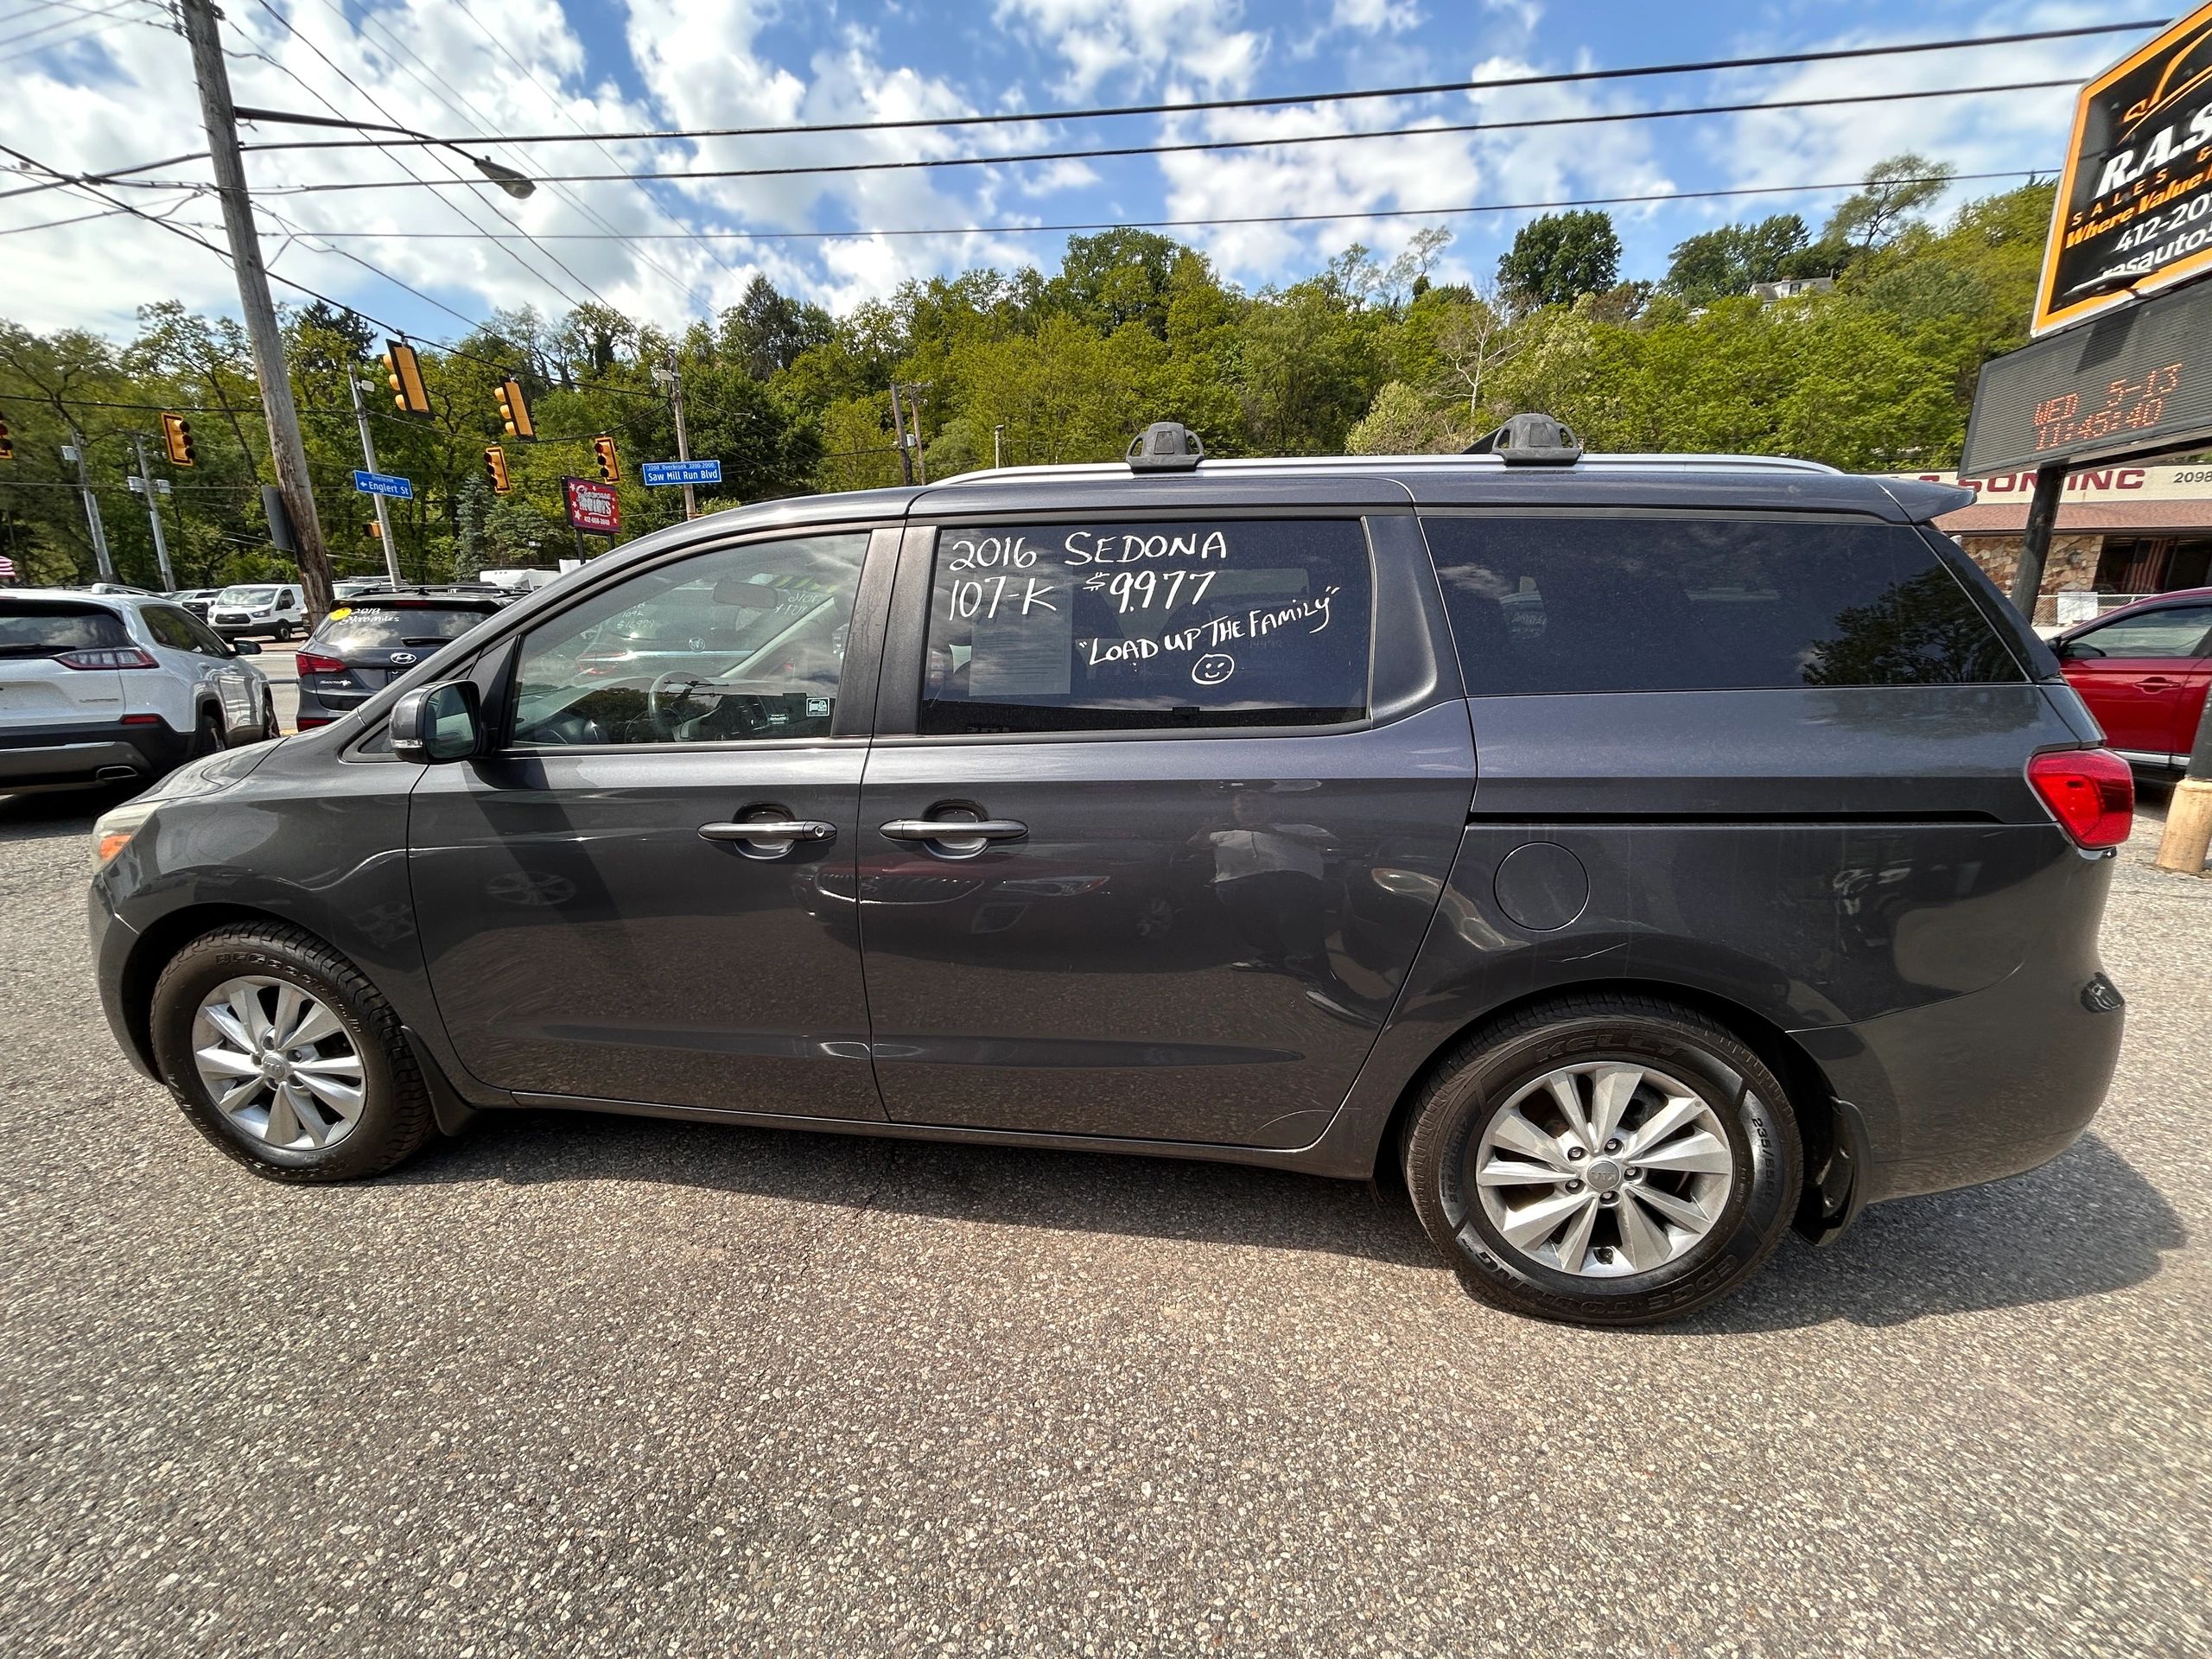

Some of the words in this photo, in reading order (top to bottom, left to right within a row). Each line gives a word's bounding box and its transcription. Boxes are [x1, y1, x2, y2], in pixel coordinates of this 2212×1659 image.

[2065, 207, 2135, 249] Where
[2138, 172, 2203, 214] Value
[2072, 168, 2168, 226] SALES
[2113, 192, 2212, 251] 412-20
[2033, 392, 2079, 425] WED
[2107, 363, 2183, 406] 5-13
[2036, 398, 2164, 450] 11:45:40
[368, 480, 399, 493] Englert
[400, 486, 410, 495] St
[648, 473, 664, 482] Saw
[666, 470, 682, 480] Mill
[683, 471, 698, 480] Run
[700, 468, 718, 479] Blvd
[2067, 469, 2145, 490] INC
[2173, 471, 2212, 483] 2098
[949, 537, 1037, 571] 2016
[1065, 531, 1227, 566] SEDONA
[949, 575, 1057, 621] 107-K
[1165, 627, 1202, 651] UP
[1201, 615, 1246, 647] THE
[1535, 1033, 1688, 1063] KELLY
